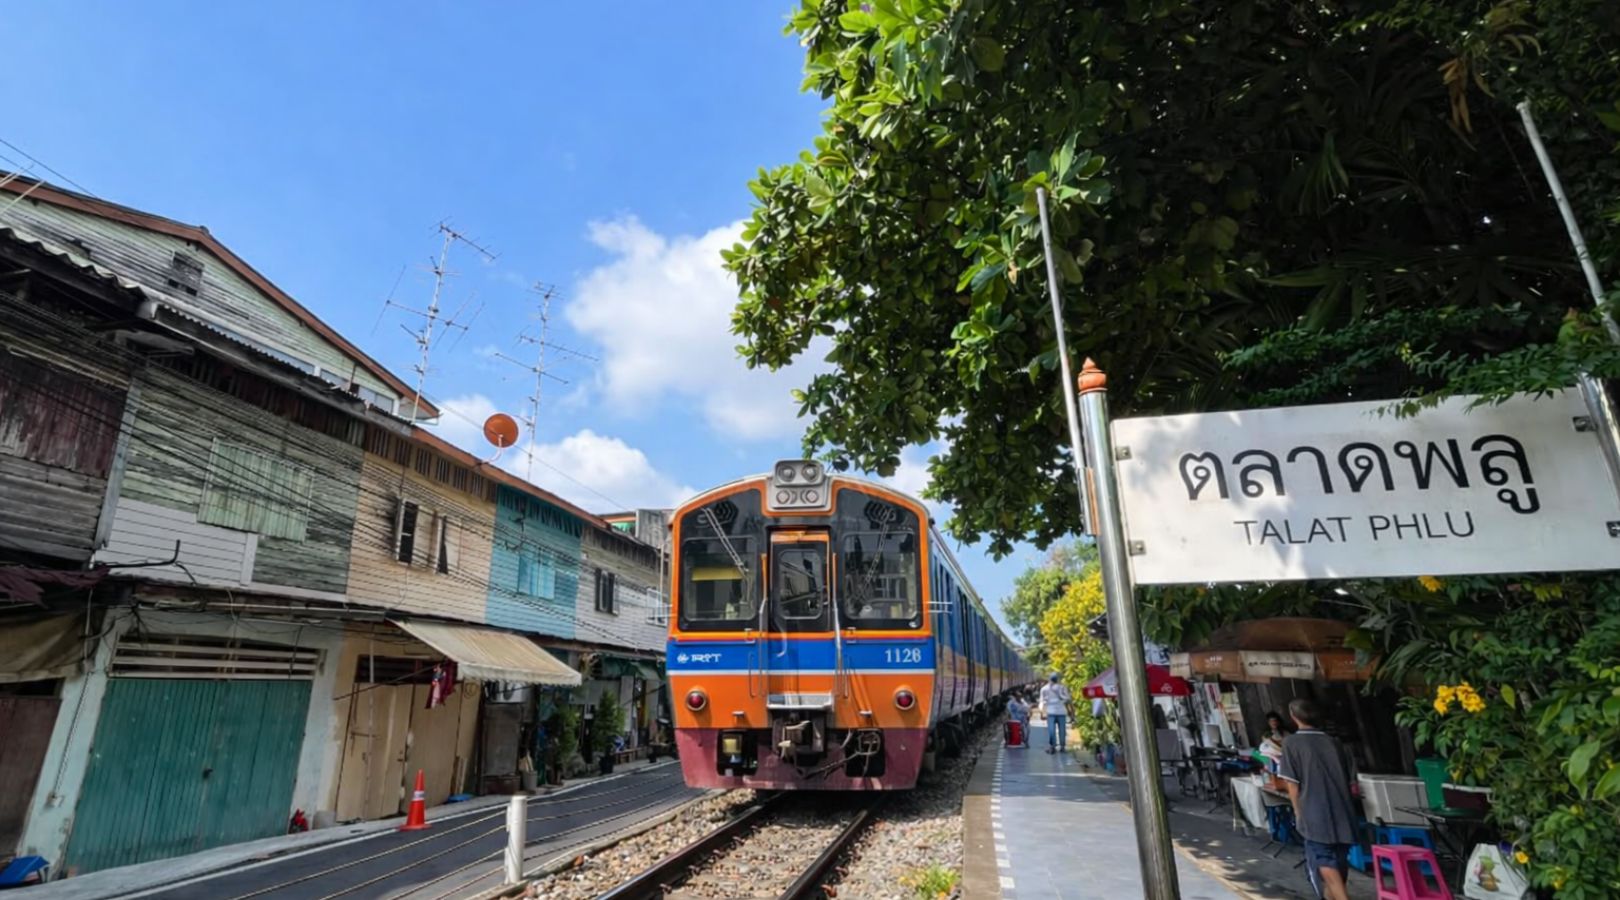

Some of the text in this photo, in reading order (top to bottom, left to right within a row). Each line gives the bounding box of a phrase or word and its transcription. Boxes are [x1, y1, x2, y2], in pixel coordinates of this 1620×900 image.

[1179, 434, 1541, 515] ตลาดพลู
[1234, 510, 1476, 546] TALAT PHLU
